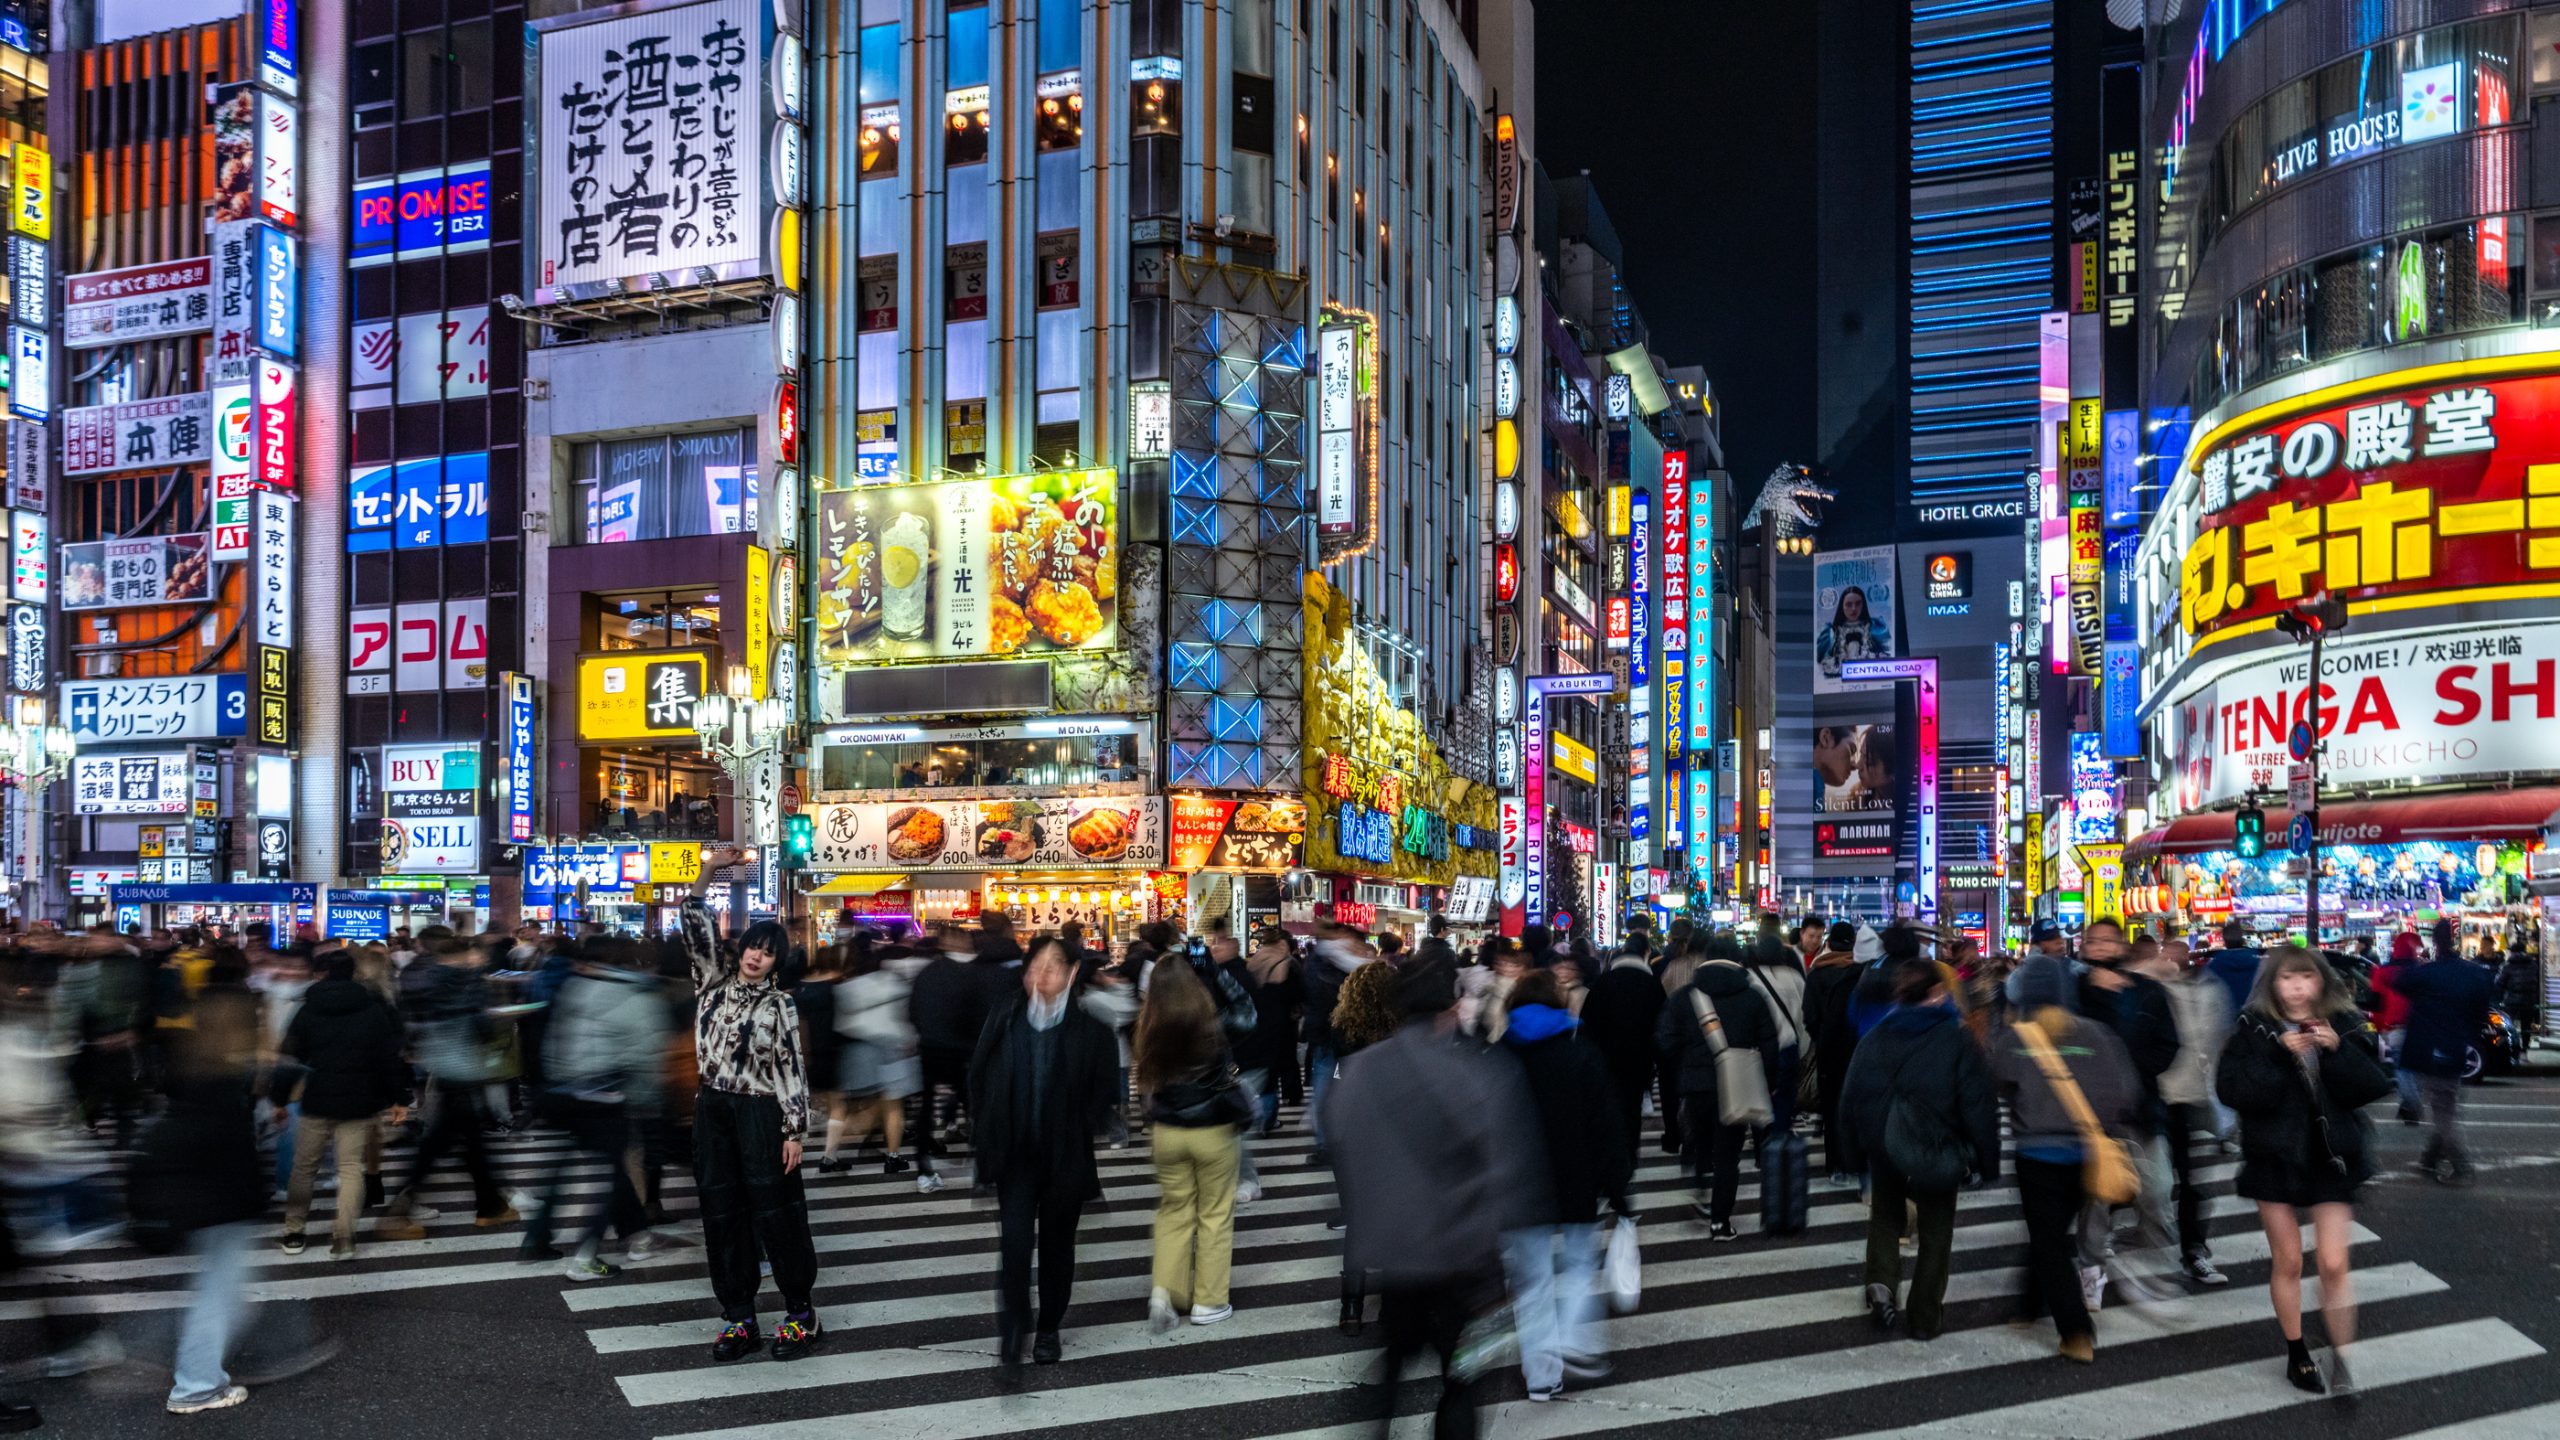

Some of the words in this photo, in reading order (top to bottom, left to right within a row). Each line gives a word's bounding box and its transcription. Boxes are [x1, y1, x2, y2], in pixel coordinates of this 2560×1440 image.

[702, 19, 746, 248] おやじが喜ぶ
[2276, 138, 2318, 180] LIVE
[2328, 110, 2400, 158] HOUSE
[669, 55, 707, 249] こだわりの
[557, 81, 605, 271] だけの店
[361, 180, 486, 228] PROMISE
[2108, 150, 2136, 327] ドン・キホーテ
[222, 240, 242, 317] 専門店
[268, 244, 286, 338] セントラル
[160, 294, 208, 325] 本陣
[126, 415, 200, 462] 本陣
[266, 407, 286, 466] アコム
[1144, 430, 1164, 453] 光
[2080, 404, 2093, 453] 生ビール
[2202, 388, 2497, 515] 驚安の殿堂
[267, 467, 284, 480] 3F
[352, 483, 488, 527] セントラル
[1329, 495, 1343, 510] 光
[1920, 506, 1969, 523] HOTEL
[1972, 502, 2024, 518] GRACE
[2078, 493, 2100, 507] 4F
[1026, 491, 1048, 565] チキンが
[1071, 480, 1108, 559] あー。
[415, 530, 430, 542] 4F
[1665, 458, 1685, 621] カラオケ歌広場
[2076, 511, 2100, 560] 麻雀
[854, 500, 879, 619] チキンにぴったり!
[1002, 528, 1025, 592] たべたい。
[1052, 524, 1080, 595] 猛烈に
[112, 580, 156, 600] 専門店
[827, 508, 853, 650] レモンサワー
[953, 568, 973, 594] 光
[1930, 583, 1953, 591] TOHO
[1930, 590, 1962, 598] CINEMAS
[1694, 491, 1708, 738] カラオケ&パーティー館
[1927, 604, 1969, 615] IMAX
[352, 614, 487, 668] アコム
[952, 631, 974, 650] 4F
[1631, 602, 1645, 665] SHINJUKU
[1846, 665, 1892, 675] CENTRAL
[1894, 664, 1922, 673] ROAD
[2280, 651, 2399, 684] WECOME!
[2425, 635, 2522, 662] 欢迎光临
[104, 682, 206, 708] メンズライフ
[360, 676, 380, 691] 3F
[648, 666, 696, 723] 集
[226, 691, 246, 719] 3
[2221, 676, 2400, 756] TENGA
[2434, 659, 2556, 727] SH
[104, 711, 186, 737] クリニック
[1058, 724, 1101, 735] MONJA
[1668, 680, 1683, 759] マツモトキヨシ
[840, 732, 906, 744] OKONOMIYAKI
[2245, 752, 2260, 766] TAX
[2261, 752, 2285, 766] FREE
[2319, 737, 2479, 771] ABUKICHO
[82, 762, 114, 779] 大衆
[392, 759, 440, 782] BUY
[1529, 714, 1541, 825] GODZILLA
[82, 782, 114, 799] 酒場
[1815, 798, 1856, 812] Silent
[1858, 796, 1894, 811] Love
[126, 803, 158, 813] ビール
[949, 805, 959, 828] そば
[1144, 799, 1159, 844] かつ丼
[1176, 807, 1224, 818] お好み焼き
[412, 824, 472, 849] SELL
[829, 807, 857, 842] 虎
[960, 805, 972, 848] かき揚げ
[1043, 803, 1052, 848] ラーメン
[1054, 802, 1065, 849] とんこつ
[1177, 820, 1224, 831] もんじゃ焼き
[1503, 803, 1518, 867] トラノコ
[1839, 824, 1891, 839] MARUHAN
[2292, 823, 2303, 850] P
[2317, 822, 2383, 845] uijote
[1127, 845, 1162, 860] 630円
[1174, 833, 1213, 845] 焼きそば
[1291, 835, 1300, 843] 2F
[677, 849, 698, 877] 集
[810, 845, 871, 863] とらそば
[943, 850, 975, 865] 600円
[1034, 850, 1067, 864] 640円
[1529, 839, 1541, 892] ROAD
[118, 888, 170, 898] SUBNADE
[293, 888, 303, 899] P
[1949, 876, 1978, 888] TOHO
[332, 908, 382, 921] SUBNADE
[1335, 902, 1376, 924] カラオケBOX
